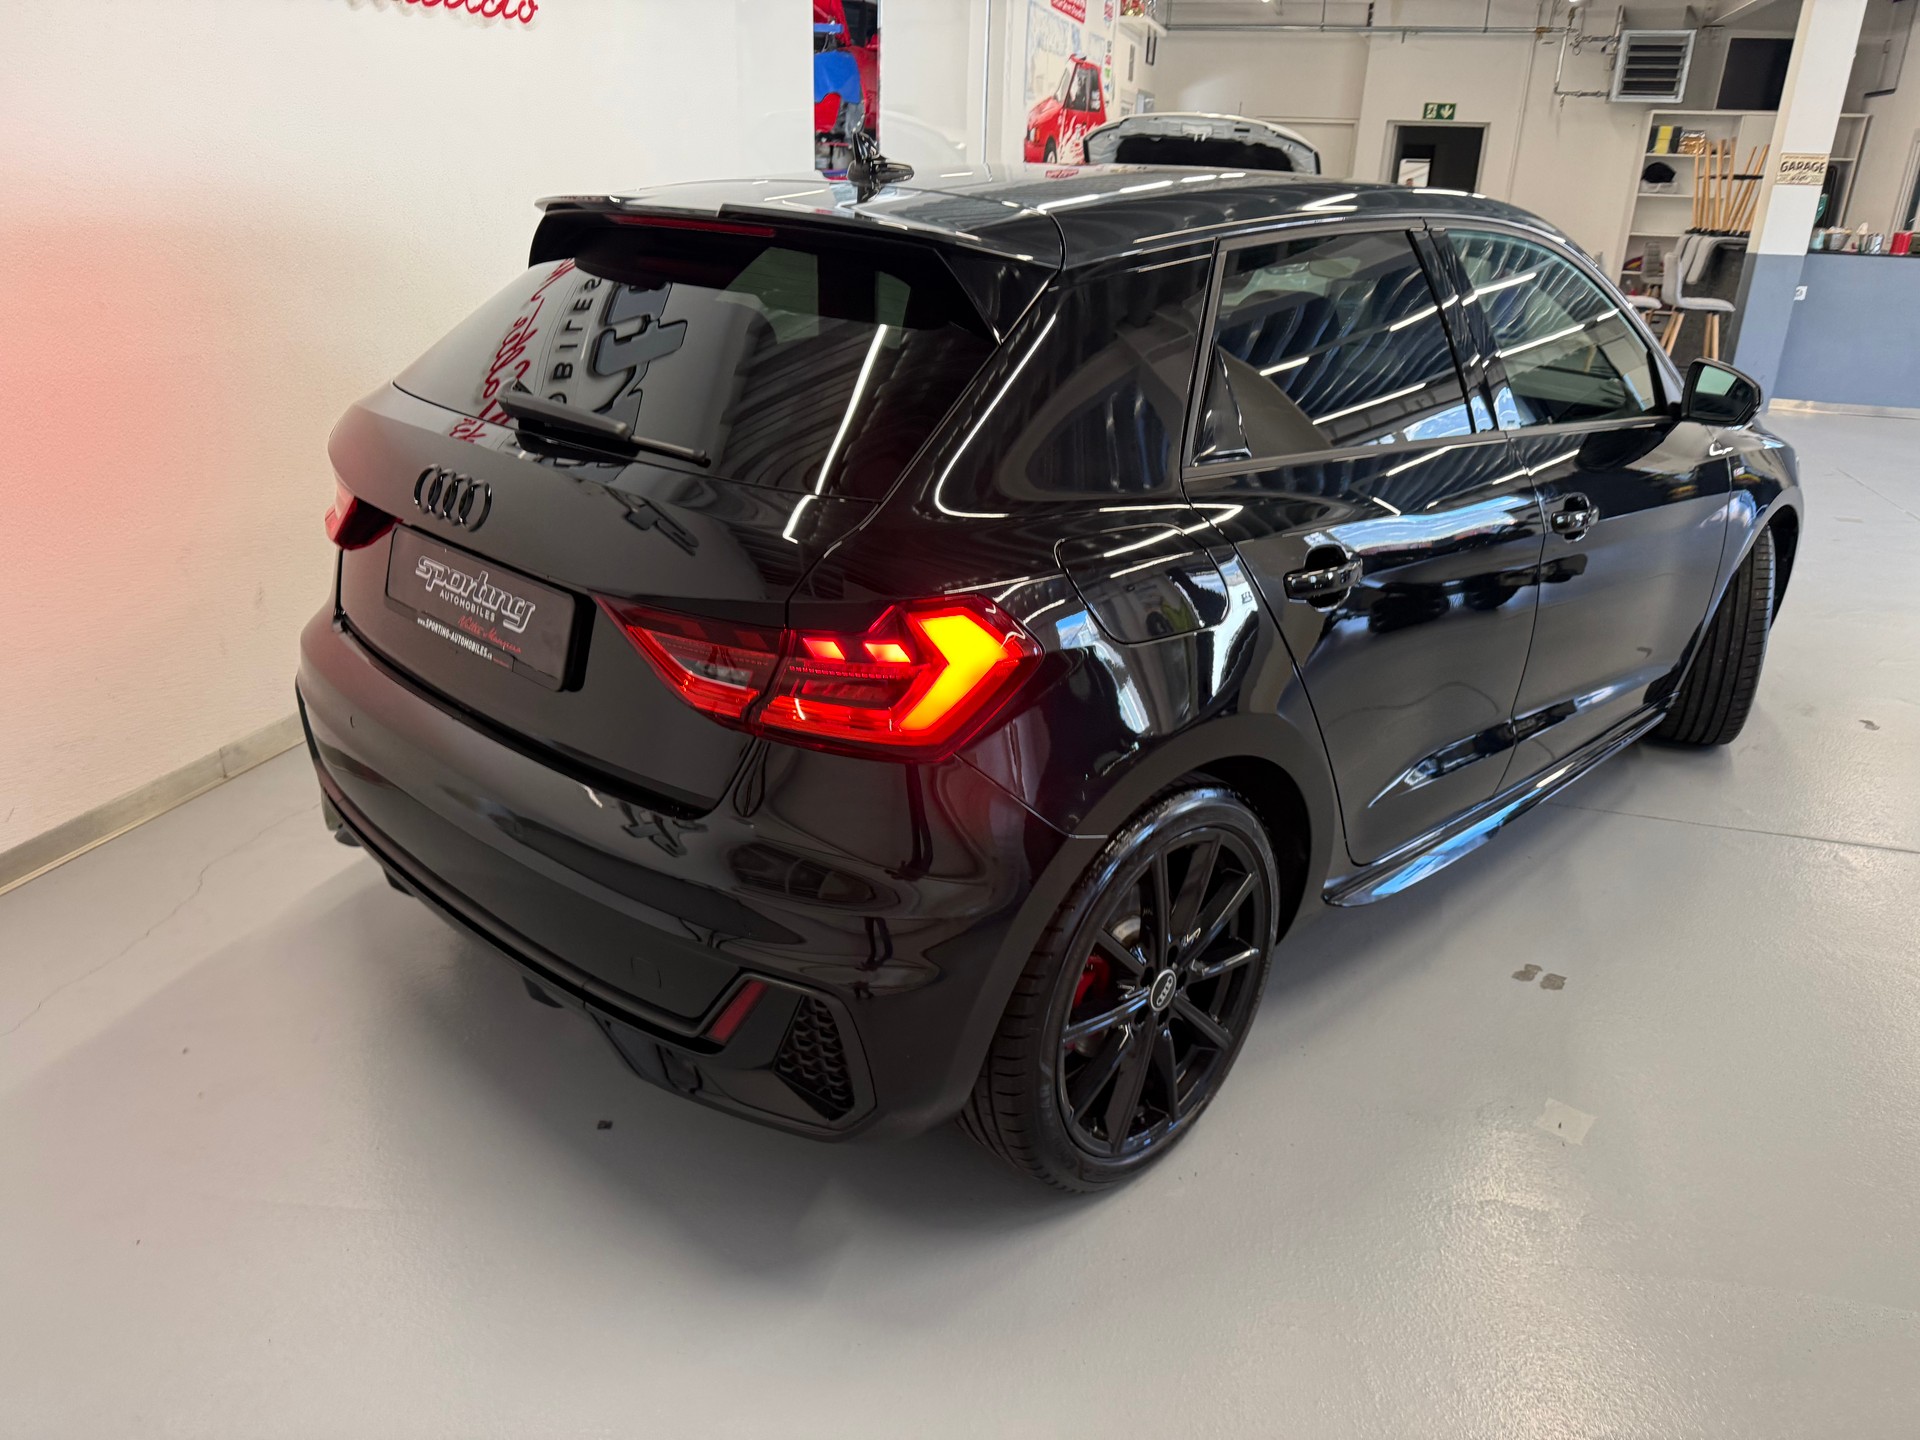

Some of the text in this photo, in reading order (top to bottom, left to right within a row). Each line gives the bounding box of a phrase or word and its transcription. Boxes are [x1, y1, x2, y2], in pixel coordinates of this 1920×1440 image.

[1781, 161, 1825, 174] GARAGE
[415, 556, 536, 633] sporting
[440, 590, 495, 622] AUTOMOBILES
